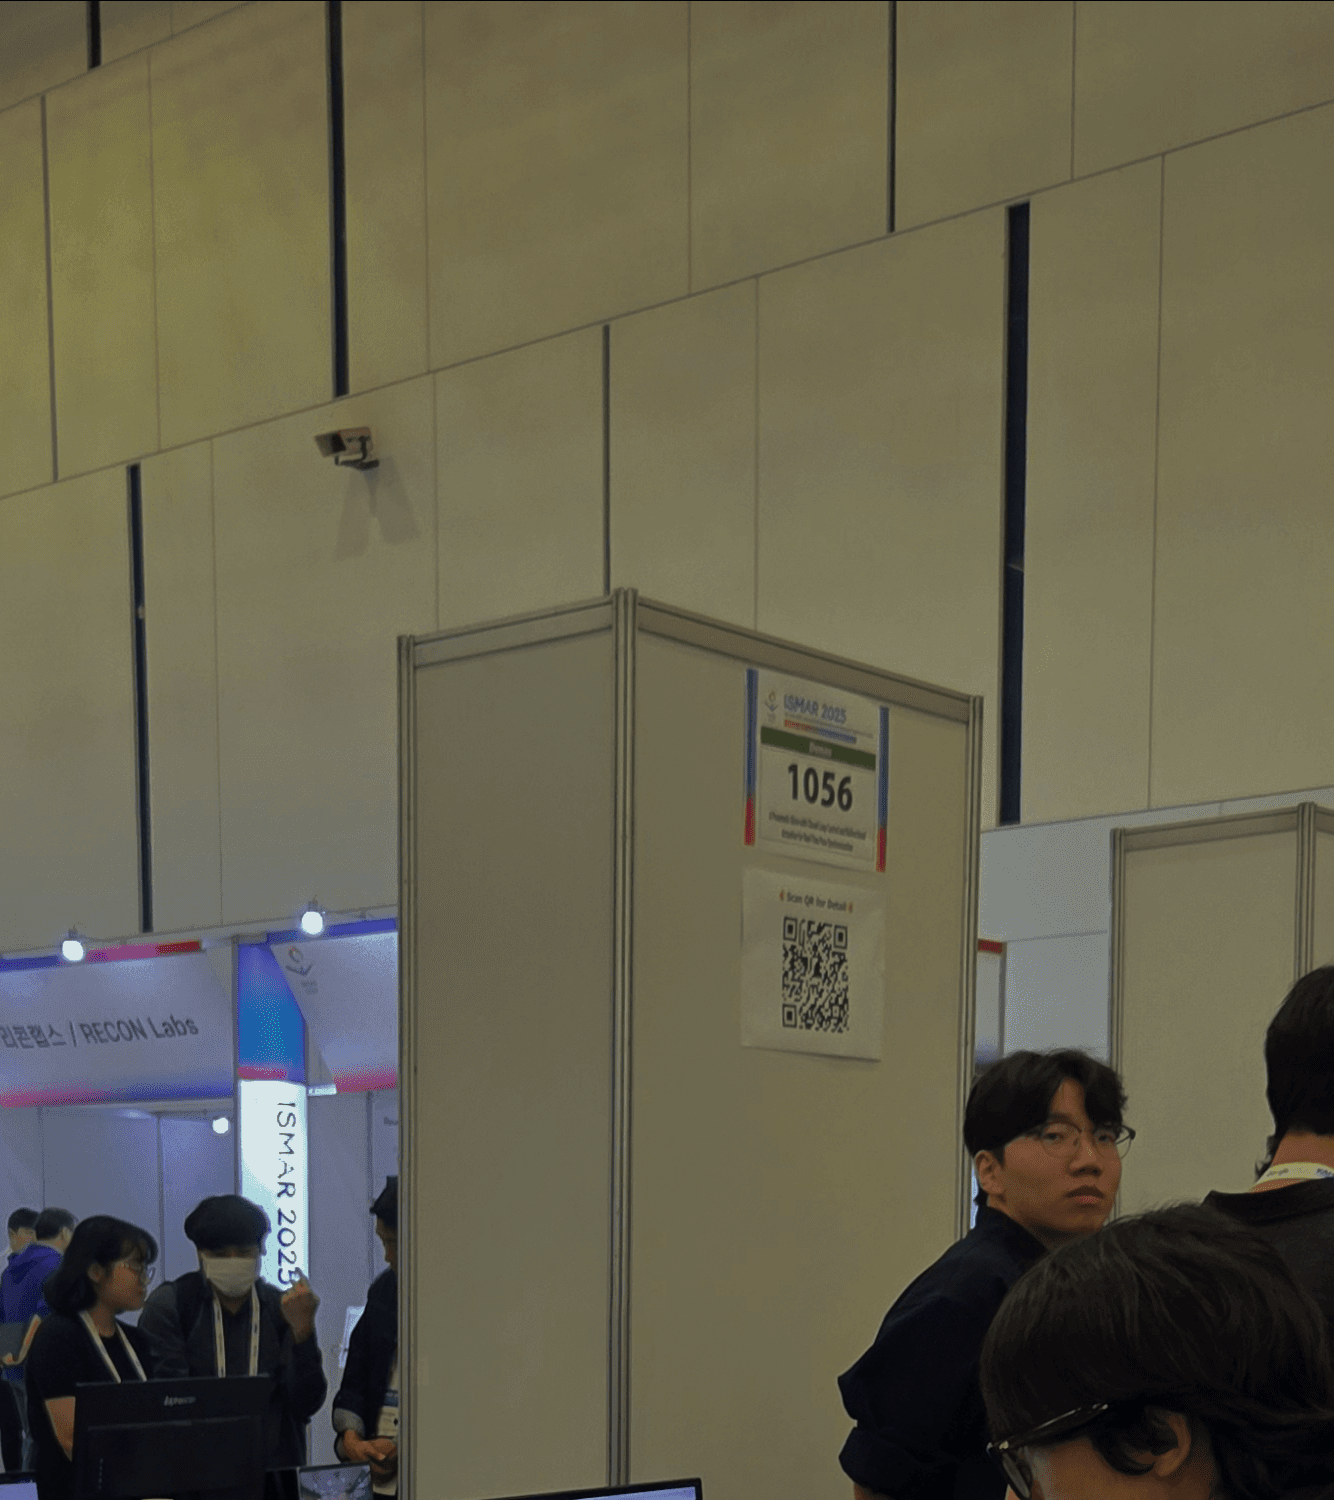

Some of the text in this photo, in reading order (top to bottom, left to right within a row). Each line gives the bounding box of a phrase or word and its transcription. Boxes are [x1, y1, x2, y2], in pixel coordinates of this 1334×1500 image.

[783, 694, 846, 724] ISMAR 2025
[788, 764, 852, 810] 1056
[79, 1018, 148, 1044] RECON
[147, 1013, 199, 1039] Labs
[276, 1102, 298, 1285] ISMAR 2025
